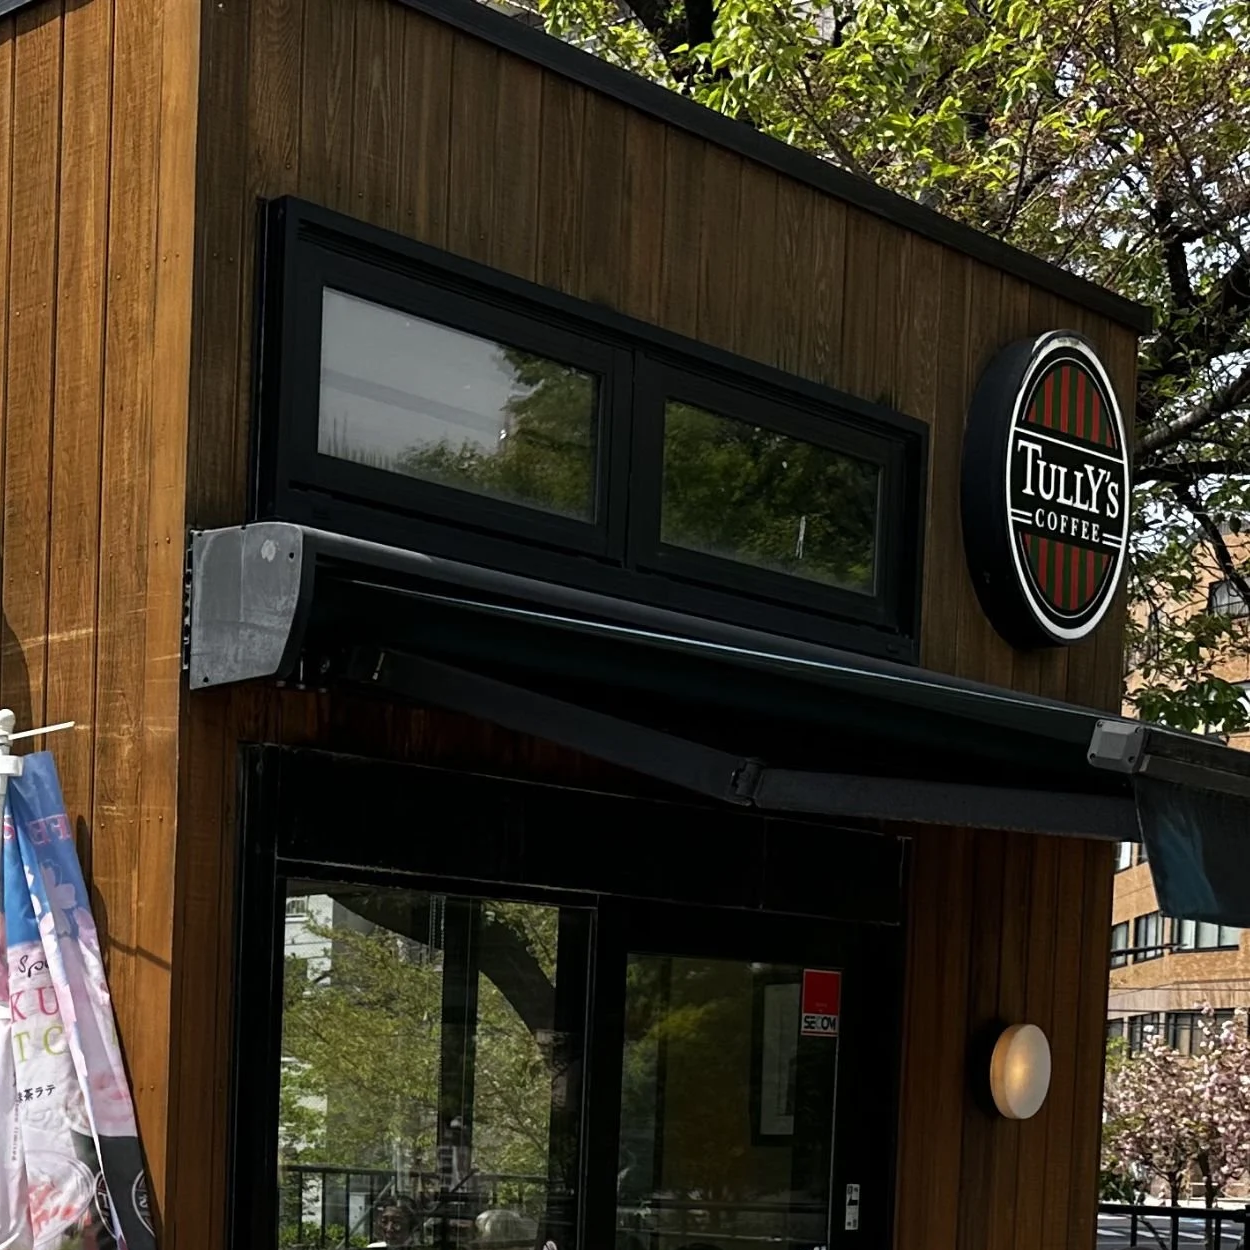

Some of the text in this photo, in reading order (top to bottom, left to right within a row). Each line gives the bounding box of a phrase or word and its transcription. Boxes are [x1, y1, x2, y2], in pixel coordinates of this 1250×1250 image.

[1017, 439, 1120, 519] TULLY'S
[1035, 508, 1100, 543] COFFEE
[804, 1015, 836, 1031] SECOM
